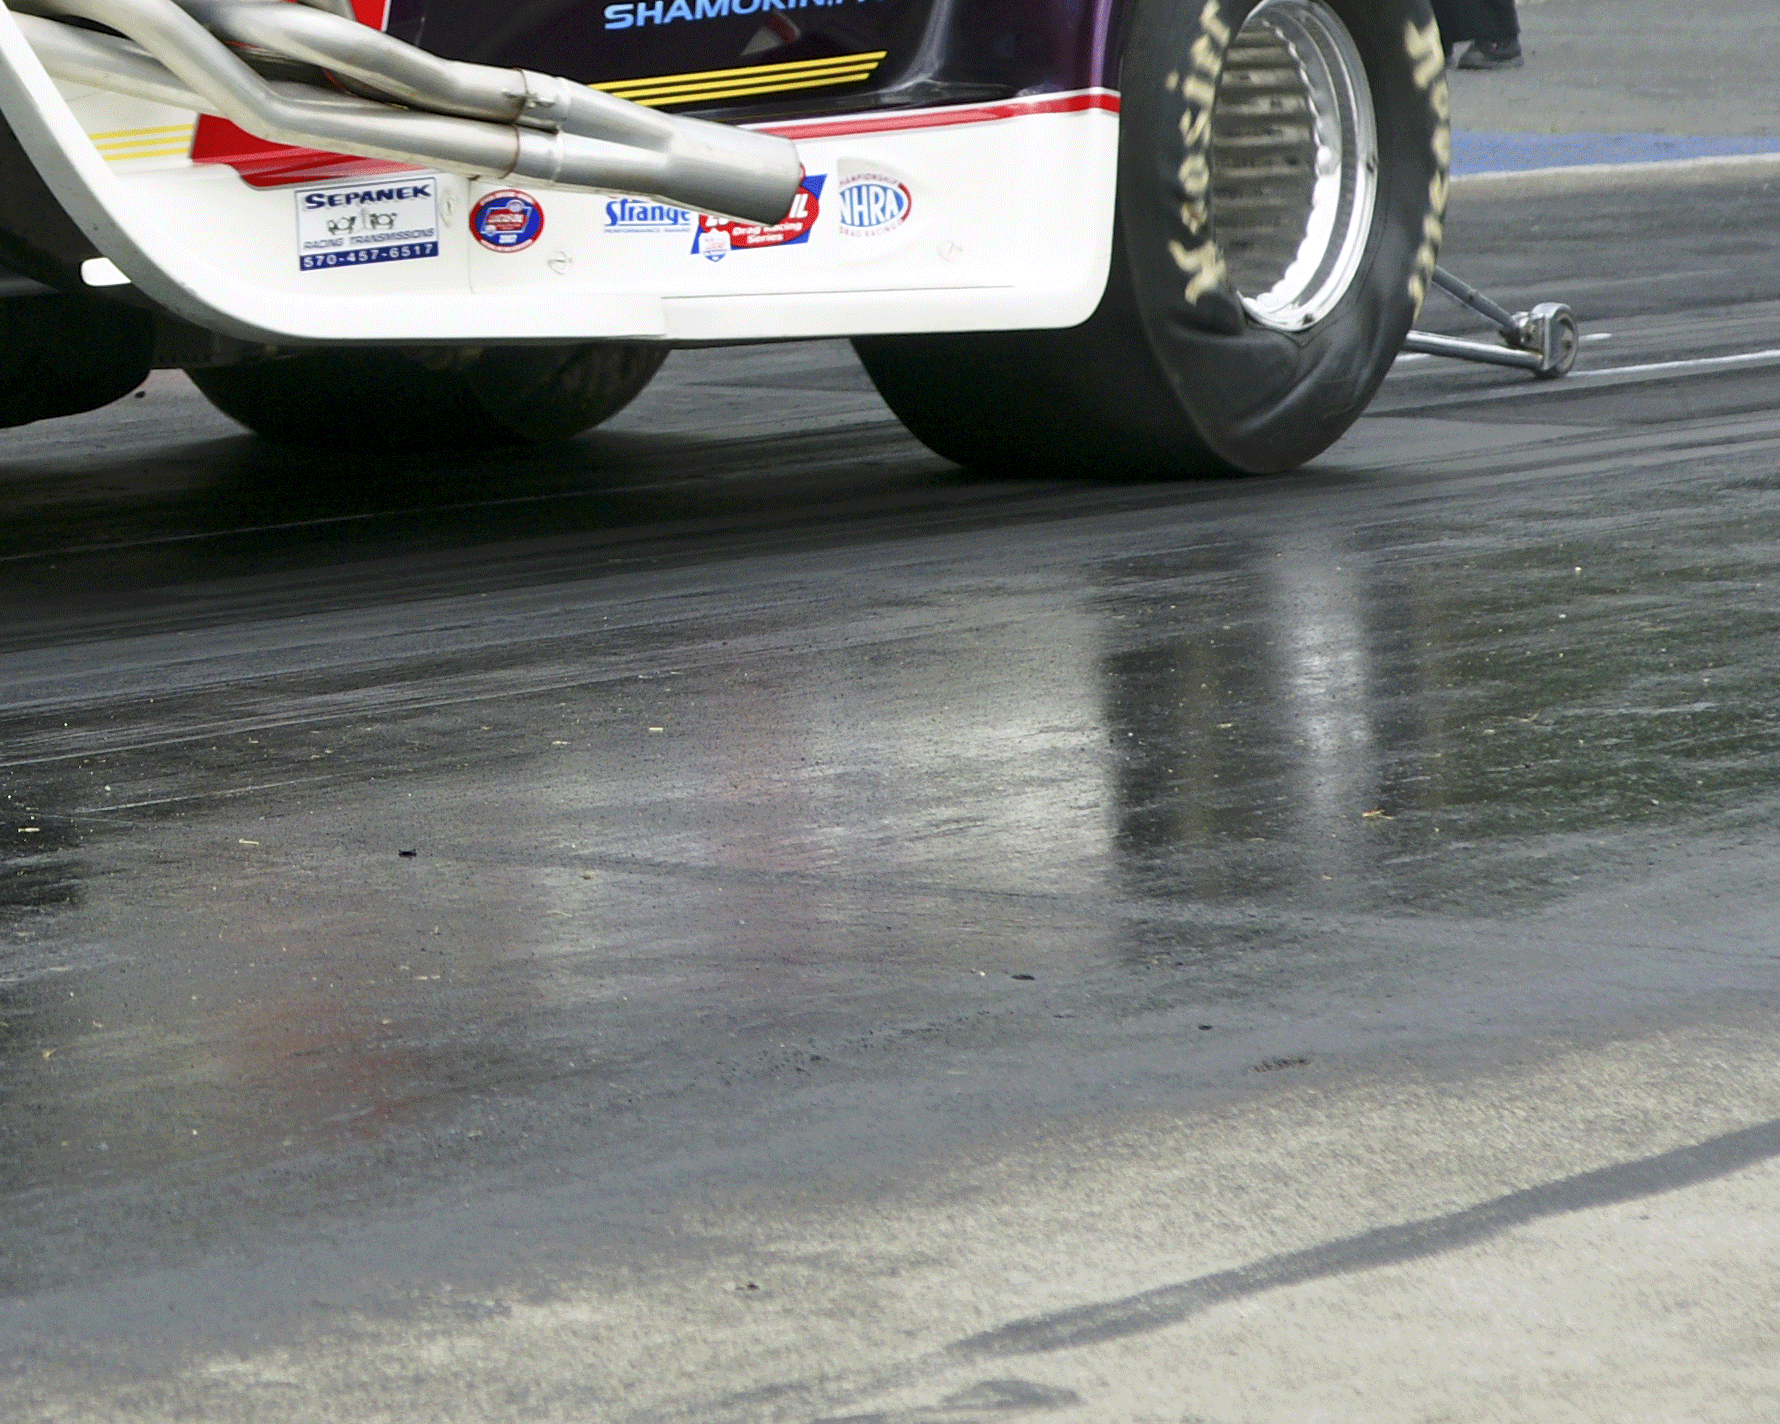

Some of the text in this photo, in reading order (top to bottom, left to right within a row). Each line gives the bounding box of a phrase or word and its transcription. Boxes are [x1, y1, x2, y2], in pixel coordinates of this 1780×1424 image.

[304, 184, 432, 210] SEPANEK
[840, 184, 904, 228] NHRA
[605, 198, 690, 226] Strange
[303, 228, 435, 249] RACING TRANSMISSIONS
[303, 243, 433, 268] 570-457-6517
